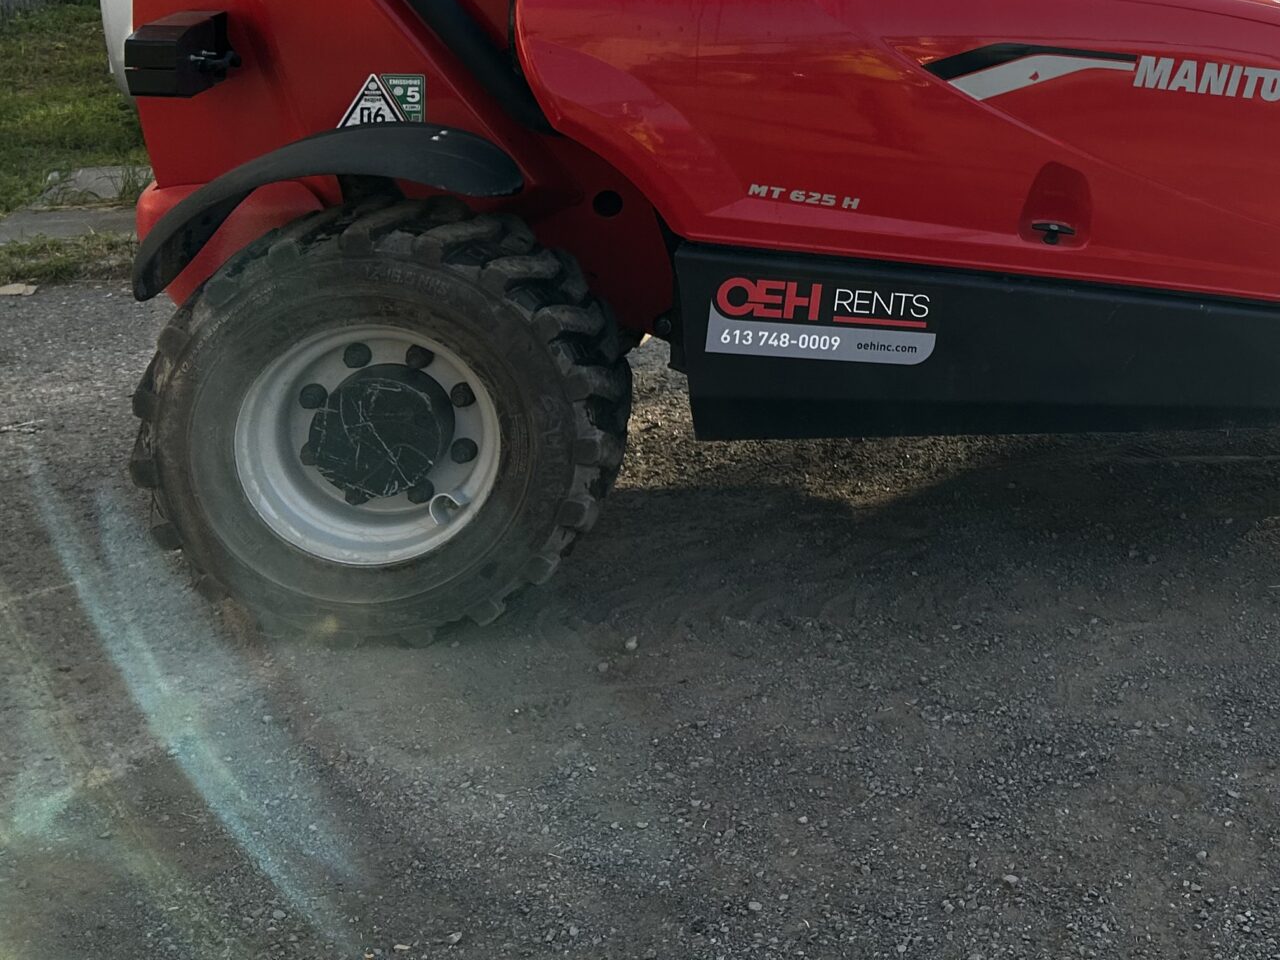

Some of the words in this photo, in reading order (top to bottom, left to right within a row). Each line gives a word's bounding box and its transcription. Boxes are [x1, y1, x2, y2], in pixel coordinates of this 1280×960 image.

[406, 86, 420, 103] 5
[747, 183, 786, 199] MT
[789, 190, 836, 207] 625
[842, 197, 861, 210] H
[716, 276, 823, 321] OEH
[833, 288, 930, 318] RENTS
[720, 329, 753, 345] 613
[758, 331, 841, 351] 748-0009
[856, 340, 918, 354] oehinc.com
